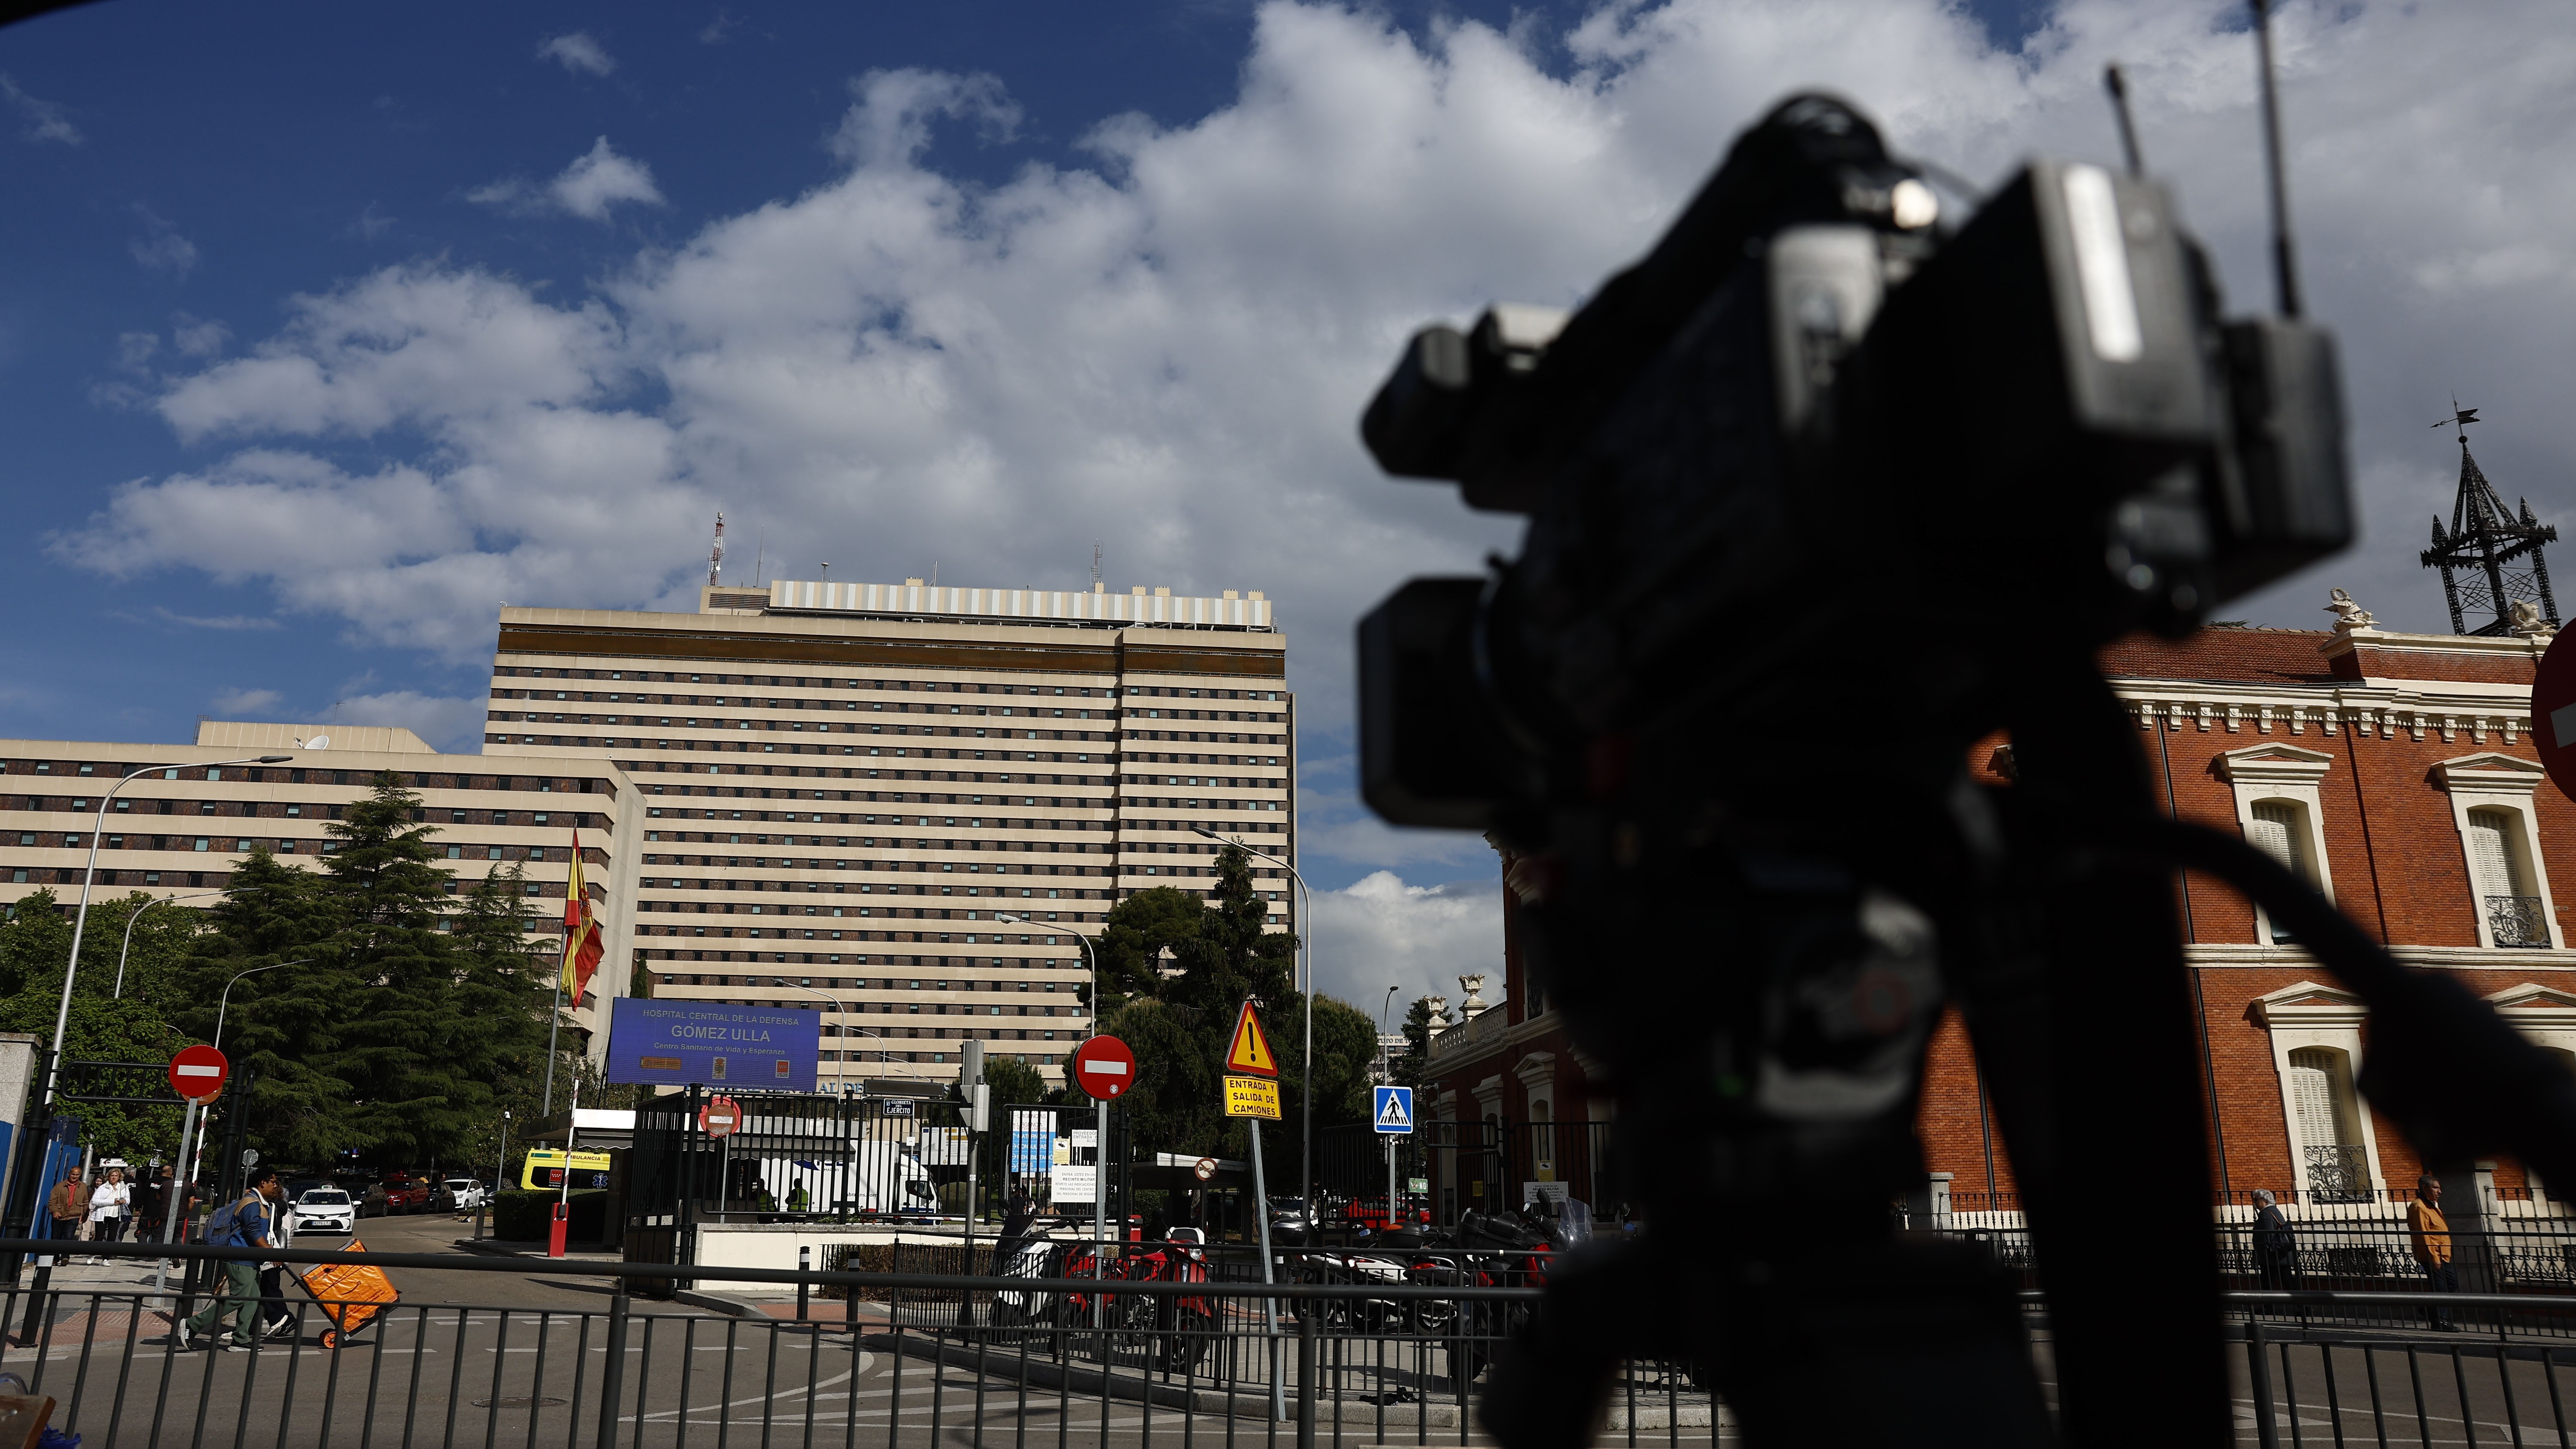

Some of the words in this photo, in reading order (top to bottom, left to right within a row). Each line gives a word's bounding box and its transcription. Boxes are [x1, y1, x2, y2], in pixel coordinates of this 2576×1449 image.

[643, 1009, 686, 1019] HOSPITAL
[689, 1012, 730, 1021] CENTRAL
[759, 1017, 799, 1025] DEFENSA
[671, 1022, 727, 1039] GÓMEZ
[732, 1028, 770, 1042] ULLA
[1229, 1080, 1267, 1091] ENTRADA
[1233, 1092, 1263, 1102] SALIDA
[1266, 1095, 1275, 1104] DE
[1233, 1104, 1276, 1115] CAMIONES
